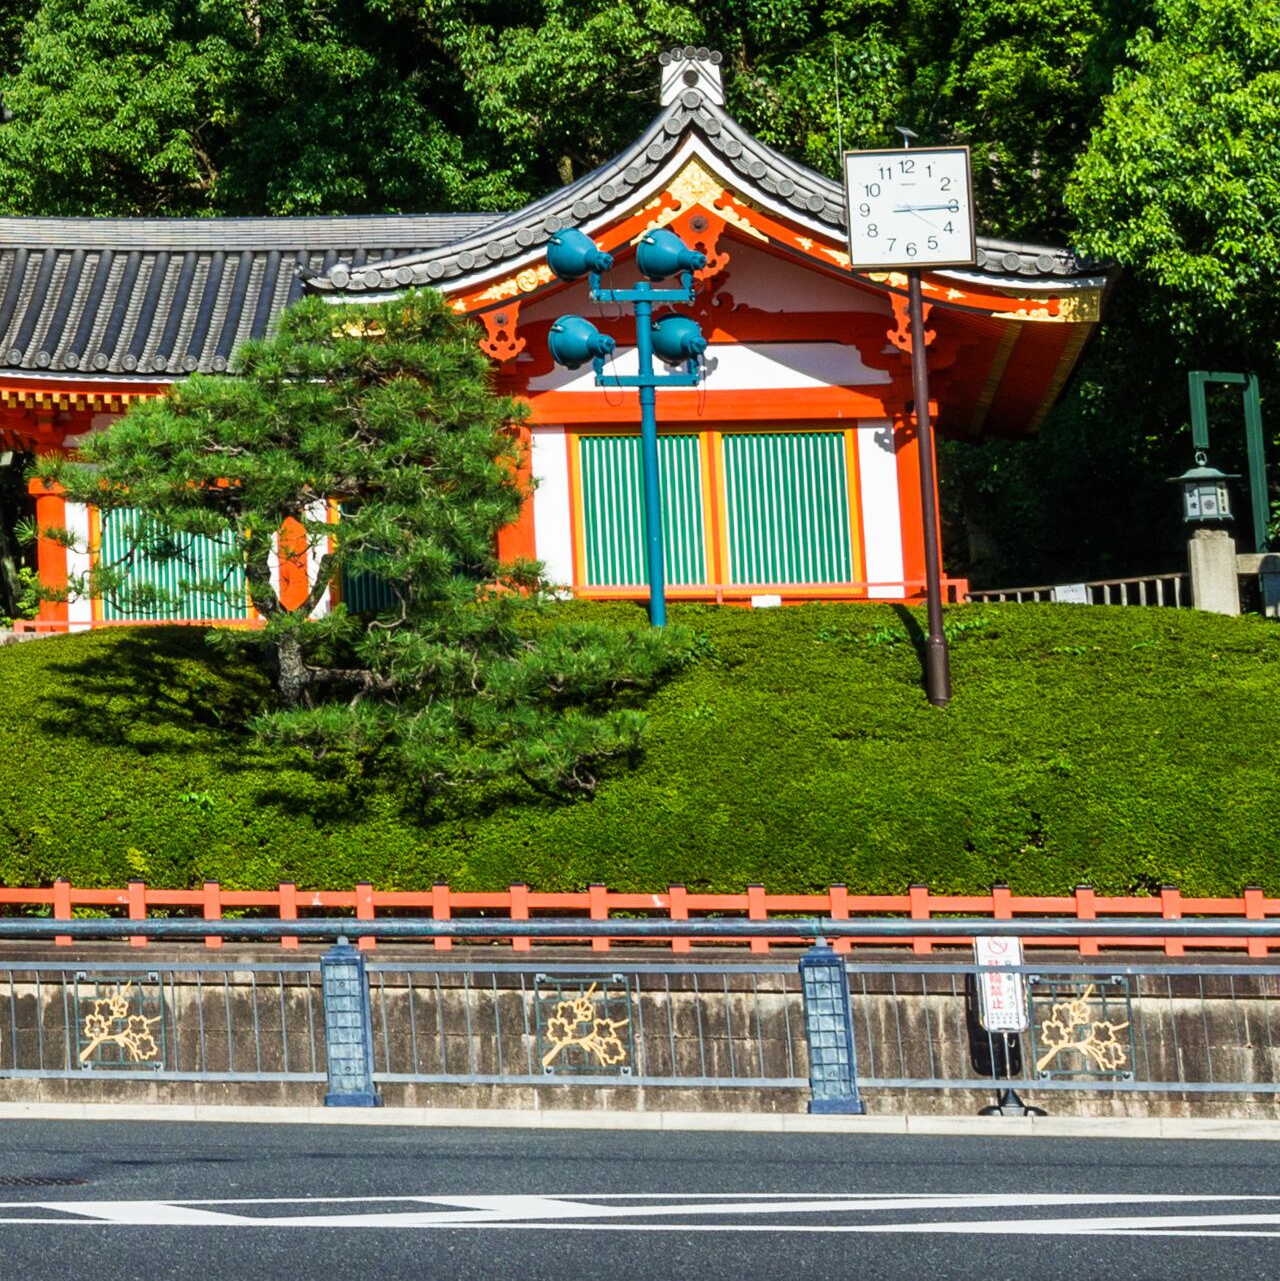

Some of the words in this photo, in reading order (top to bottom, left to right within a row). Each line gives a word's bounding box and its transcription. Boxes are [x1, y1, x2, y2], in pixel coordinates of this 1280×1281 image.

[879, 166, 892, 180] 11
[898, 159, 915, 174] 12
[925, 164, 932, 178] 1
[864, 182, 881, 198] 10
[940, 176, 951, 191] 2
[859, 202, 871, 218] 9
[947, 198, 960, 213] 3
[866, 223, 879, 238] 8
[943, 220, 954, 234] 4
[887, 237, 896, 252] 7
[906, 242, 917, 257] 6
[927, 235, 939, 250] 5
